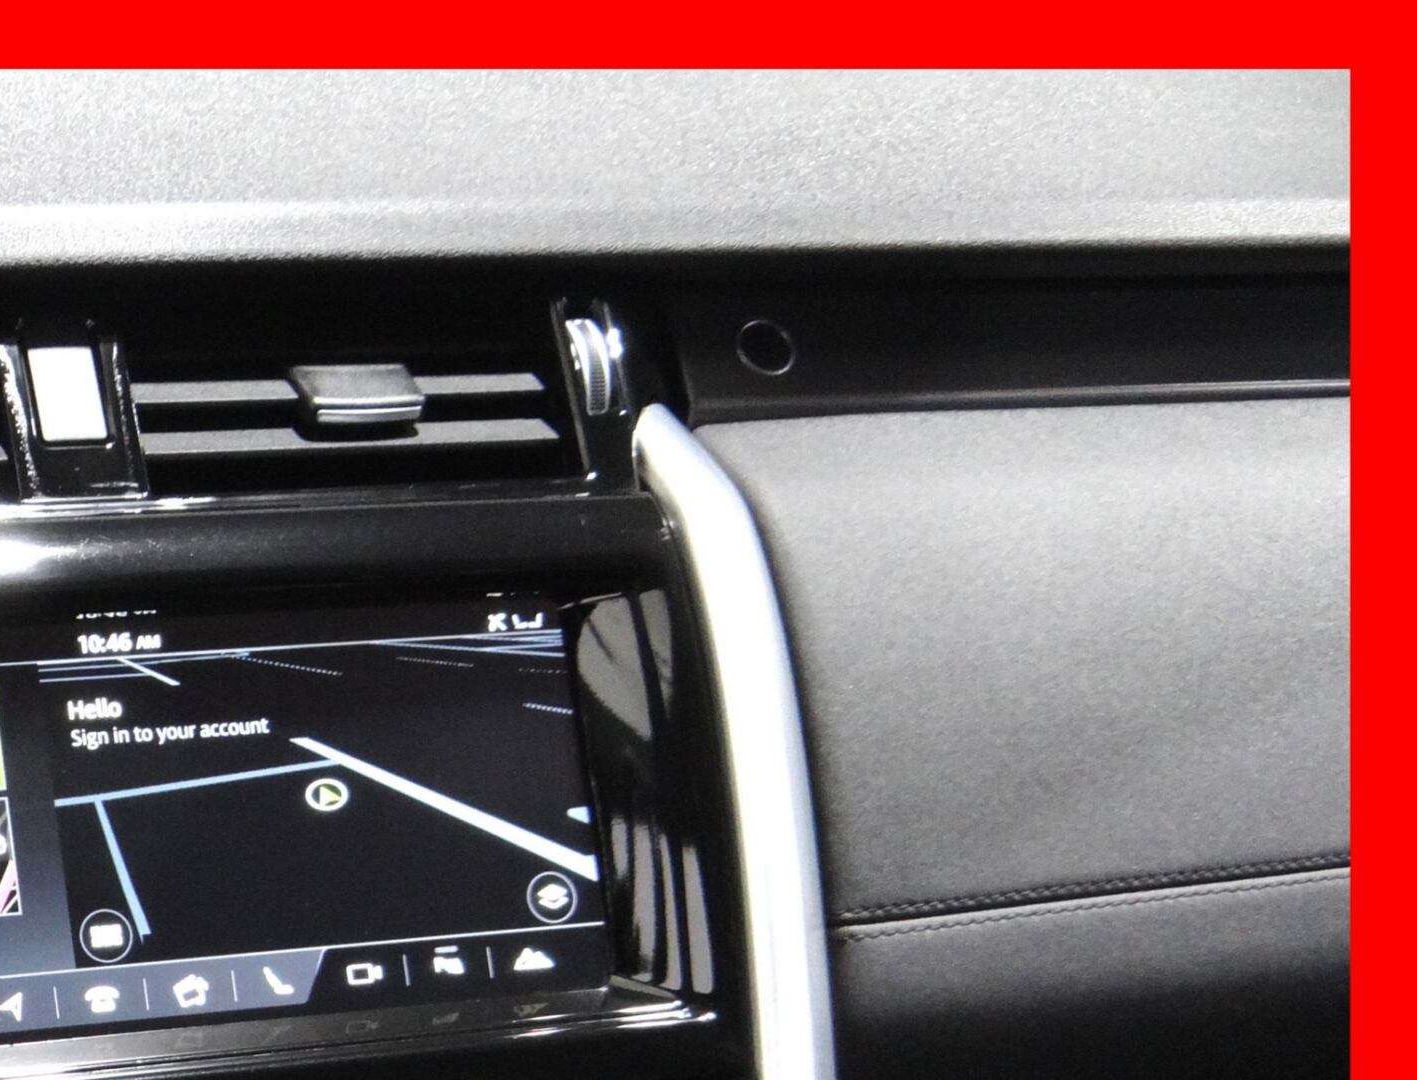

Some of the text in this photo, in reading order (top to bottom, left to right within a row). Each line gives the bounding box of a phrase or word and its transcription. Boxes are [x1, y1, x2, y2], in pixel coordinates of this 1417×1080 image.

[77, 632, 161, 654] 10:46 AM
[67, 697, 122, 720] Hello
[71, 718, 270, 750] Sign in to your account
